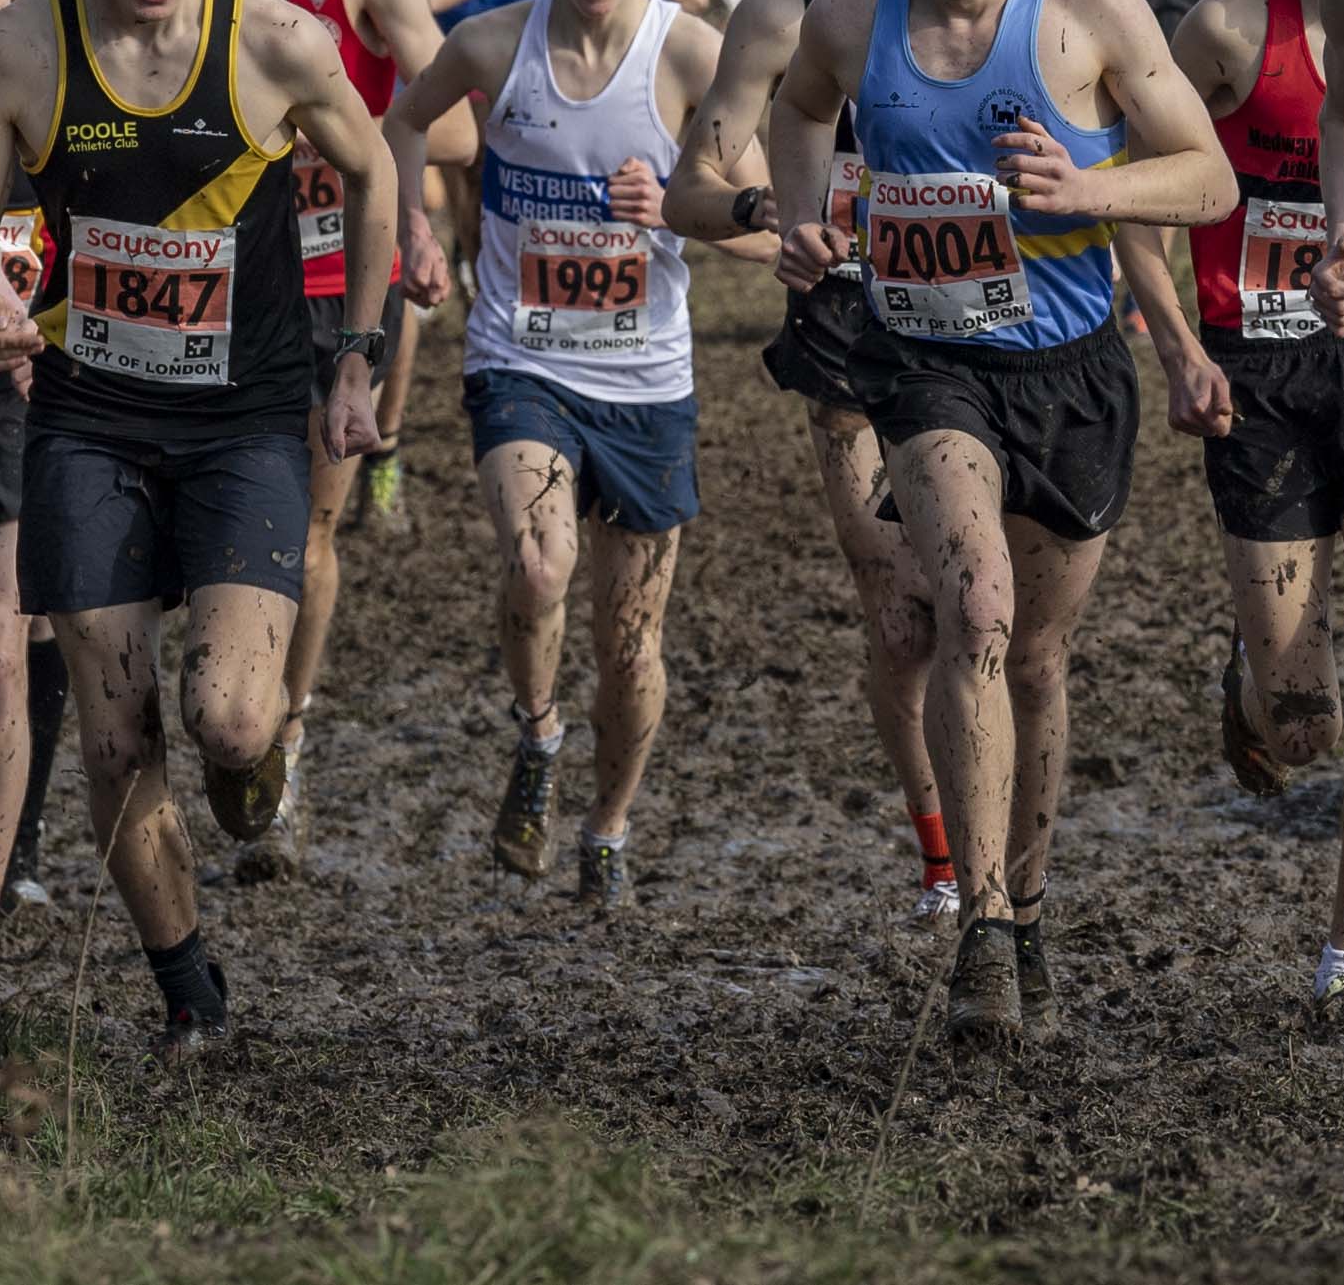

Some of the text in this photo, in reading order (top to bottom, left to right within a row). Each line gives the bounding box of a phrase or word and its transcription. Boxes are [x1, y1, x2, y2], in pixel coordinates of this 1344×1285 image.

[66, 121, 138, 141] POOLE
[67, 137, 139, 152] Athletic Club
[876, 182, 994, 209] saucony
[86, 227, 222, 262] saucony
[302, 239, 341, 255] ONDO
[530, 227, 640, 249] saucony
[879, 220, 1007, 282] 2004
[93, 263, 224, 327] 1847
[536, 257, 639, 307] 1995
[886, 304, 1026, 331] CITY OF LONDON
[1250, 318, 1291, 331] CITY
[1297, 318, 1321, 331] OF
[520, 336, 645, 350] CITY OF LONDON
[72, 343, 221, 376] CITY OF LONDON
